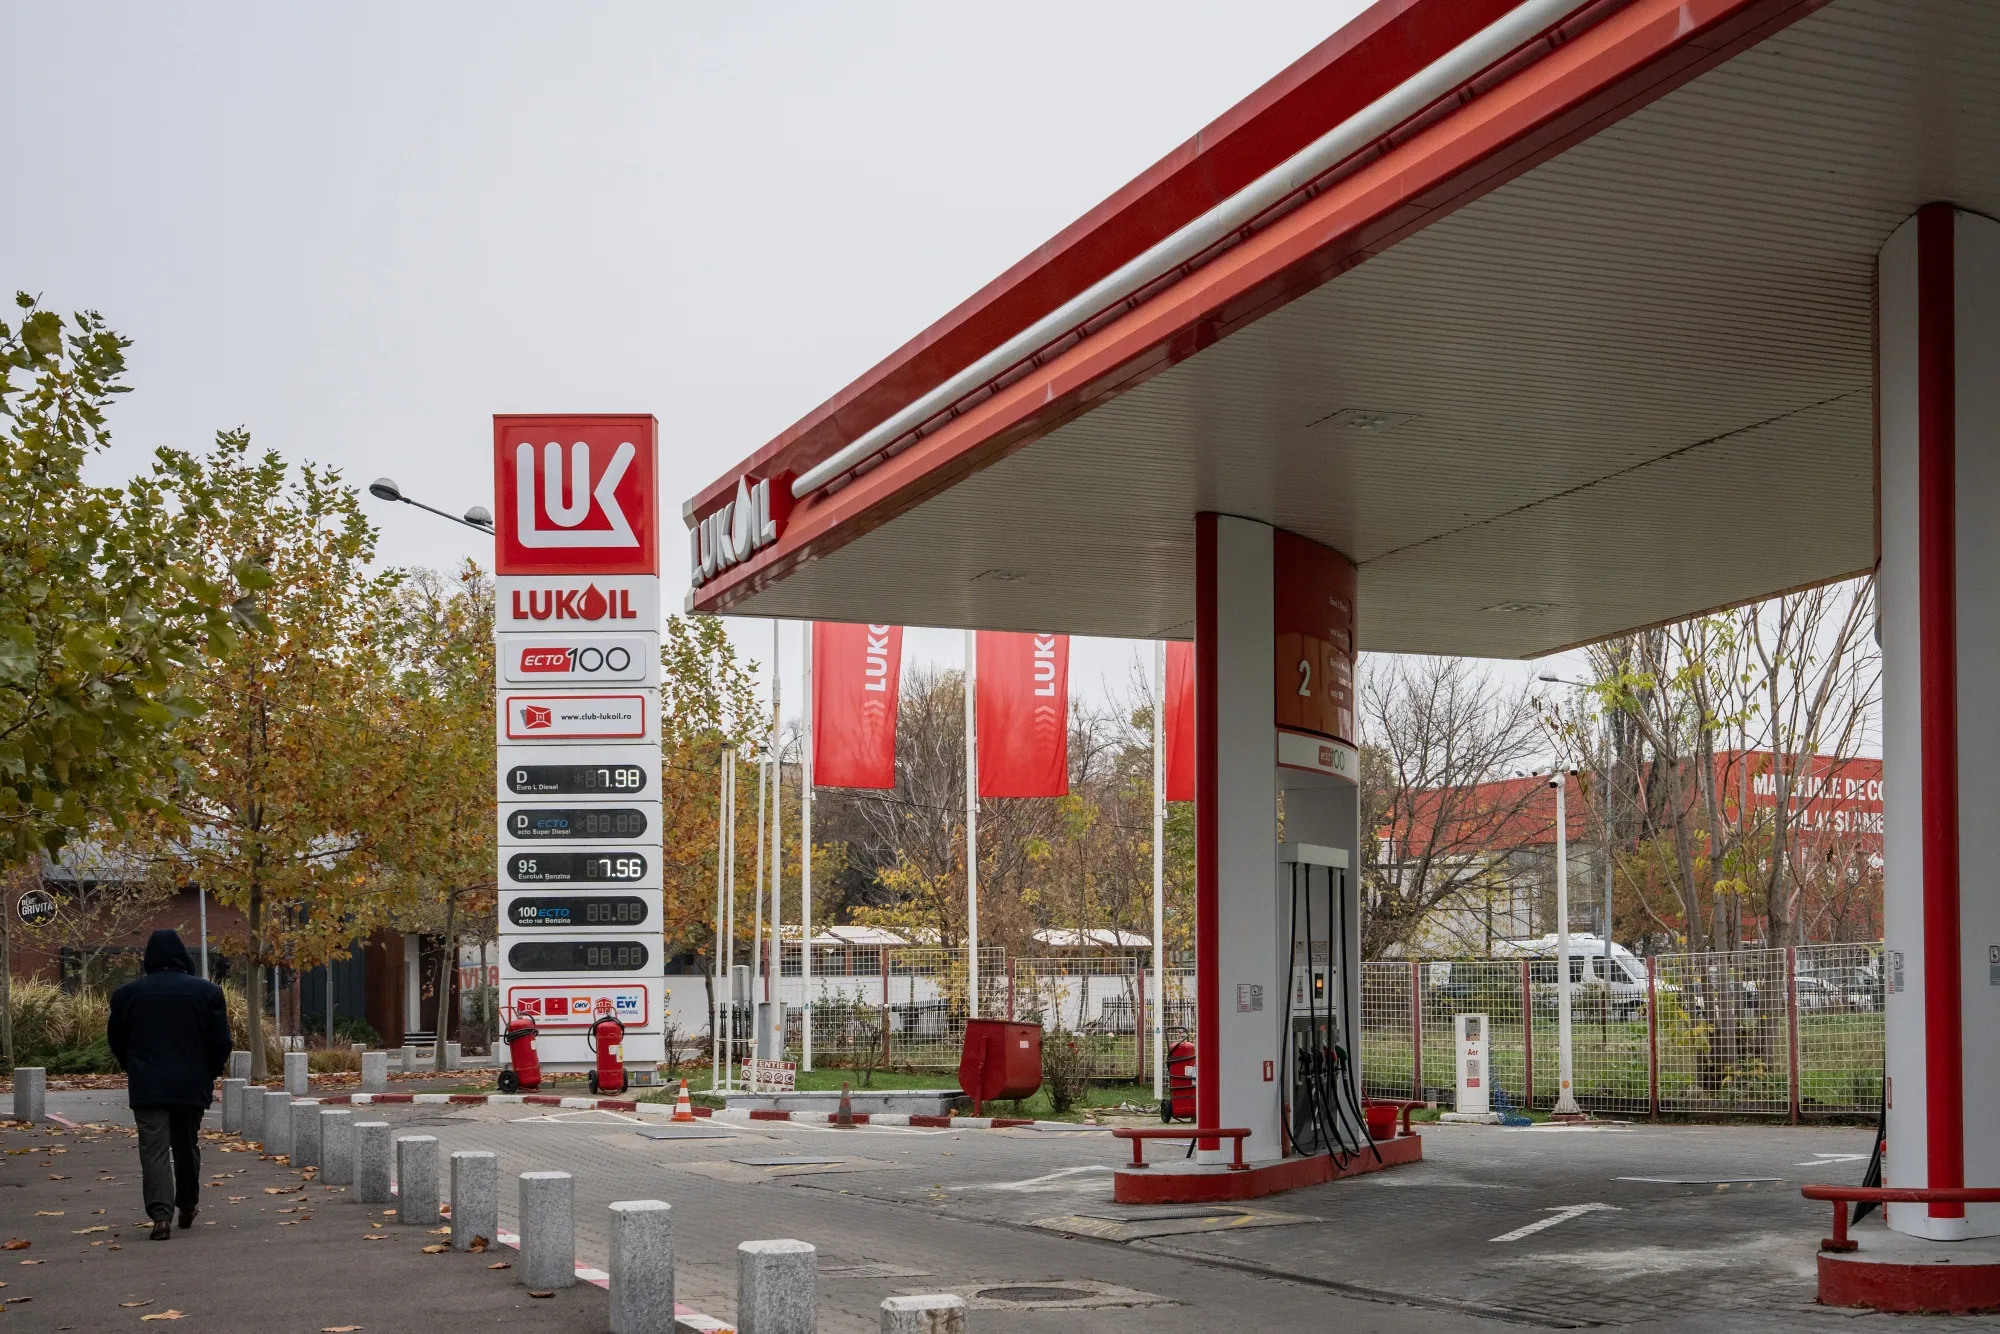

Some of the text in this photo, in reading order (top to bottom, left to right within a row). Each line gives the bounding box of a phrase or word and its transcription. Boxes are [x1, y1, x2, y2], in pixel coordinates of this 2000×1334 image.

[516, 442, 640, 548] LUK
[690, 475, 776, 588] LUKOIL
[513, 582, 637, 621] LUKOIL
[1035, 634, 1056, 696] LUK
[1298, 660, 1310, 697] 2
[517, 769, 640, 788] D 7.98
[518, 816, 528, 827] D
[518, 859, 641, 877] 95 7.56
[518, 907, 570, 917] 100 ECTO
